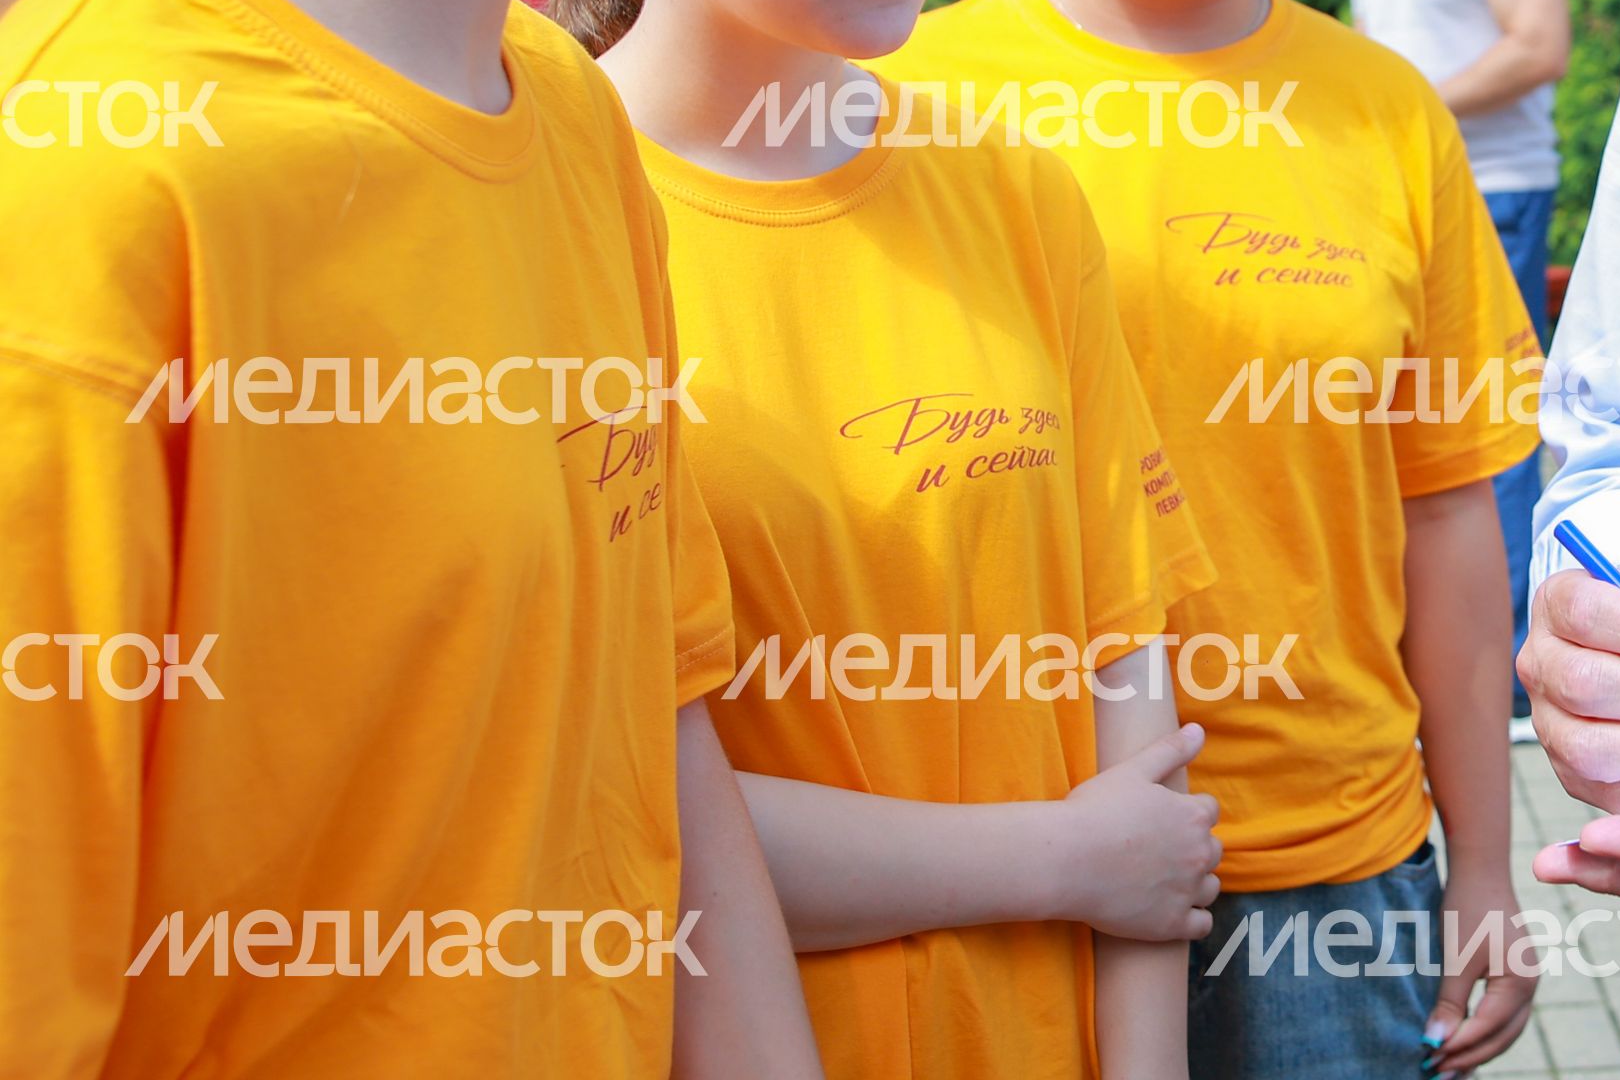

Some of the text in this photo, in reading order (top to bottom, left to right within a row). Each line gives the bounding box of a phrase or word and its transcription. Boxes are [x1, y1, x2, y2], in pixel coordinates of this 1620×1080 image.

[1214, 267, 1241, 287] и
[839, 393, 1012, 456] Будь
[915, 464, 951, 494] и
[609, 504, 634, 543] и
